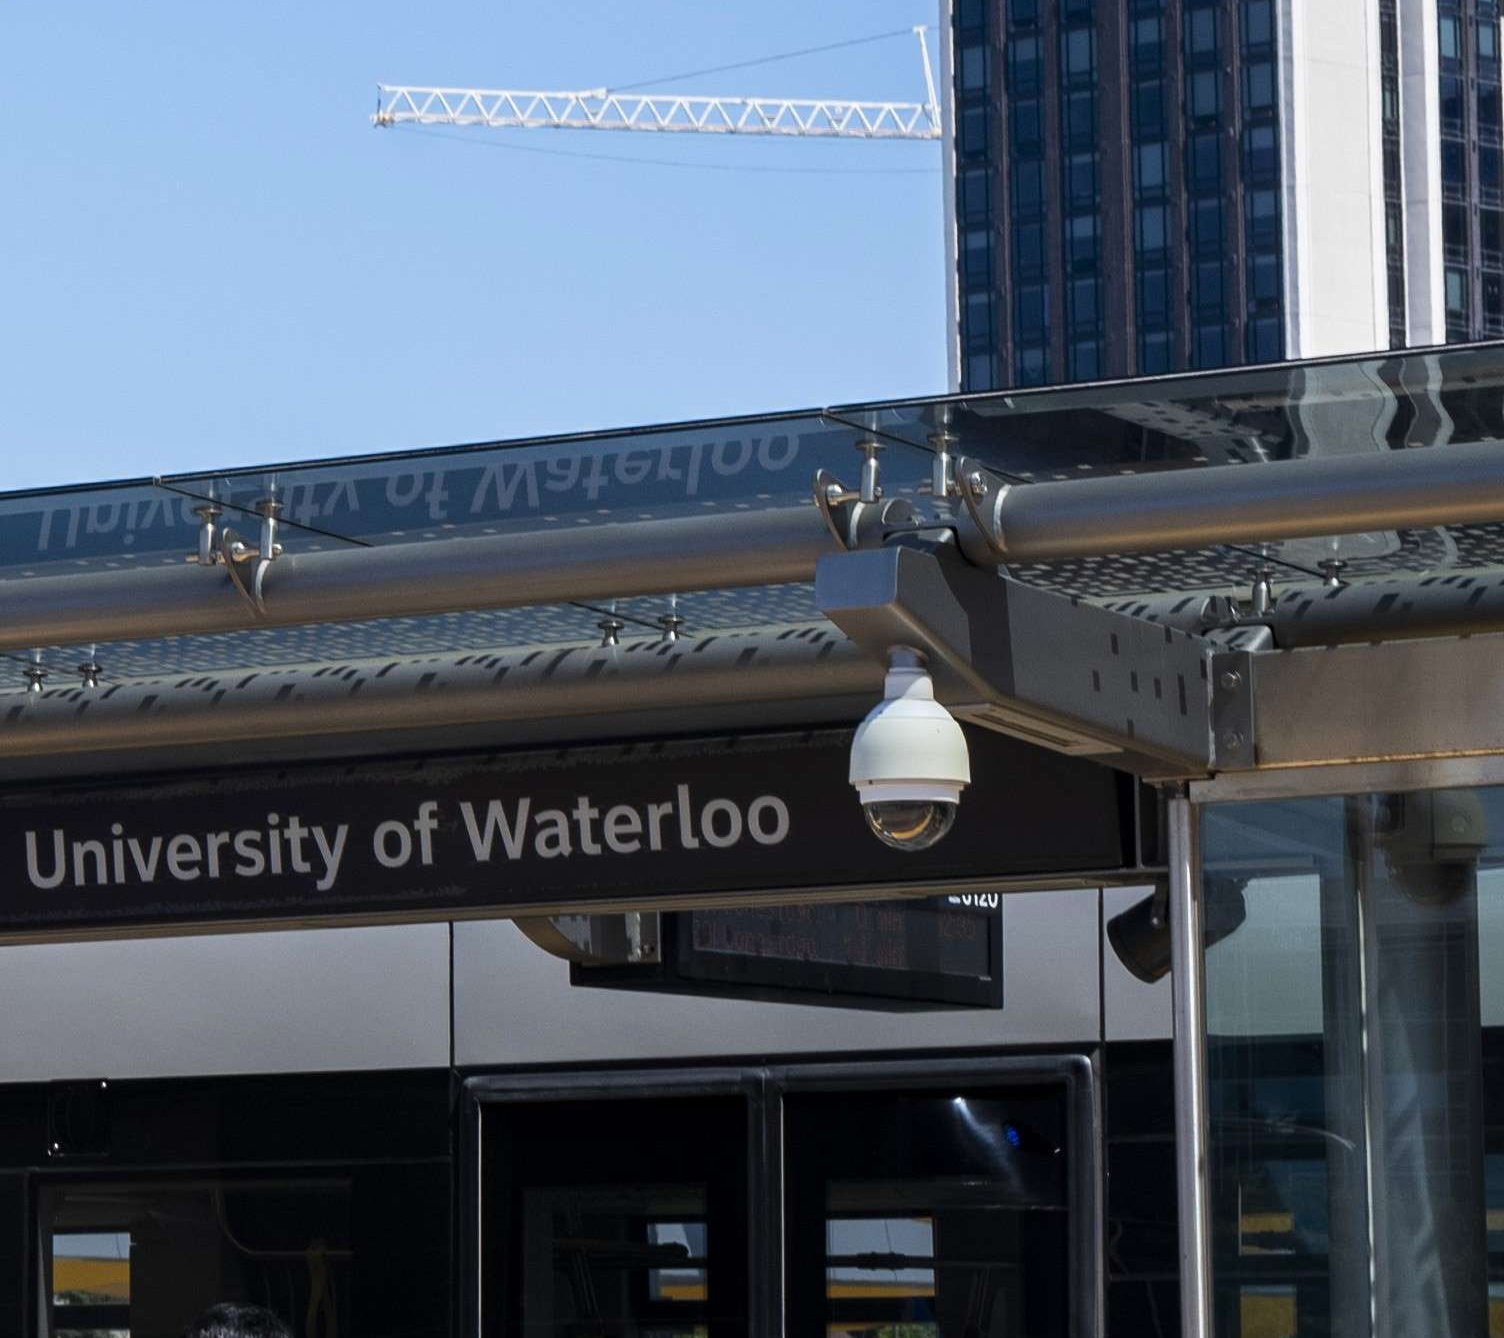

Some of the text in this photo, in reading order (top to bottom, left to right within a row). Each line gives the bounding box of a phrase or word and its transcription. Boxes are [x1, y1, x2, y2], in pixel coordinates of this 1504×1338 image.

[24, 784, 791, 891] University of Waterloo
